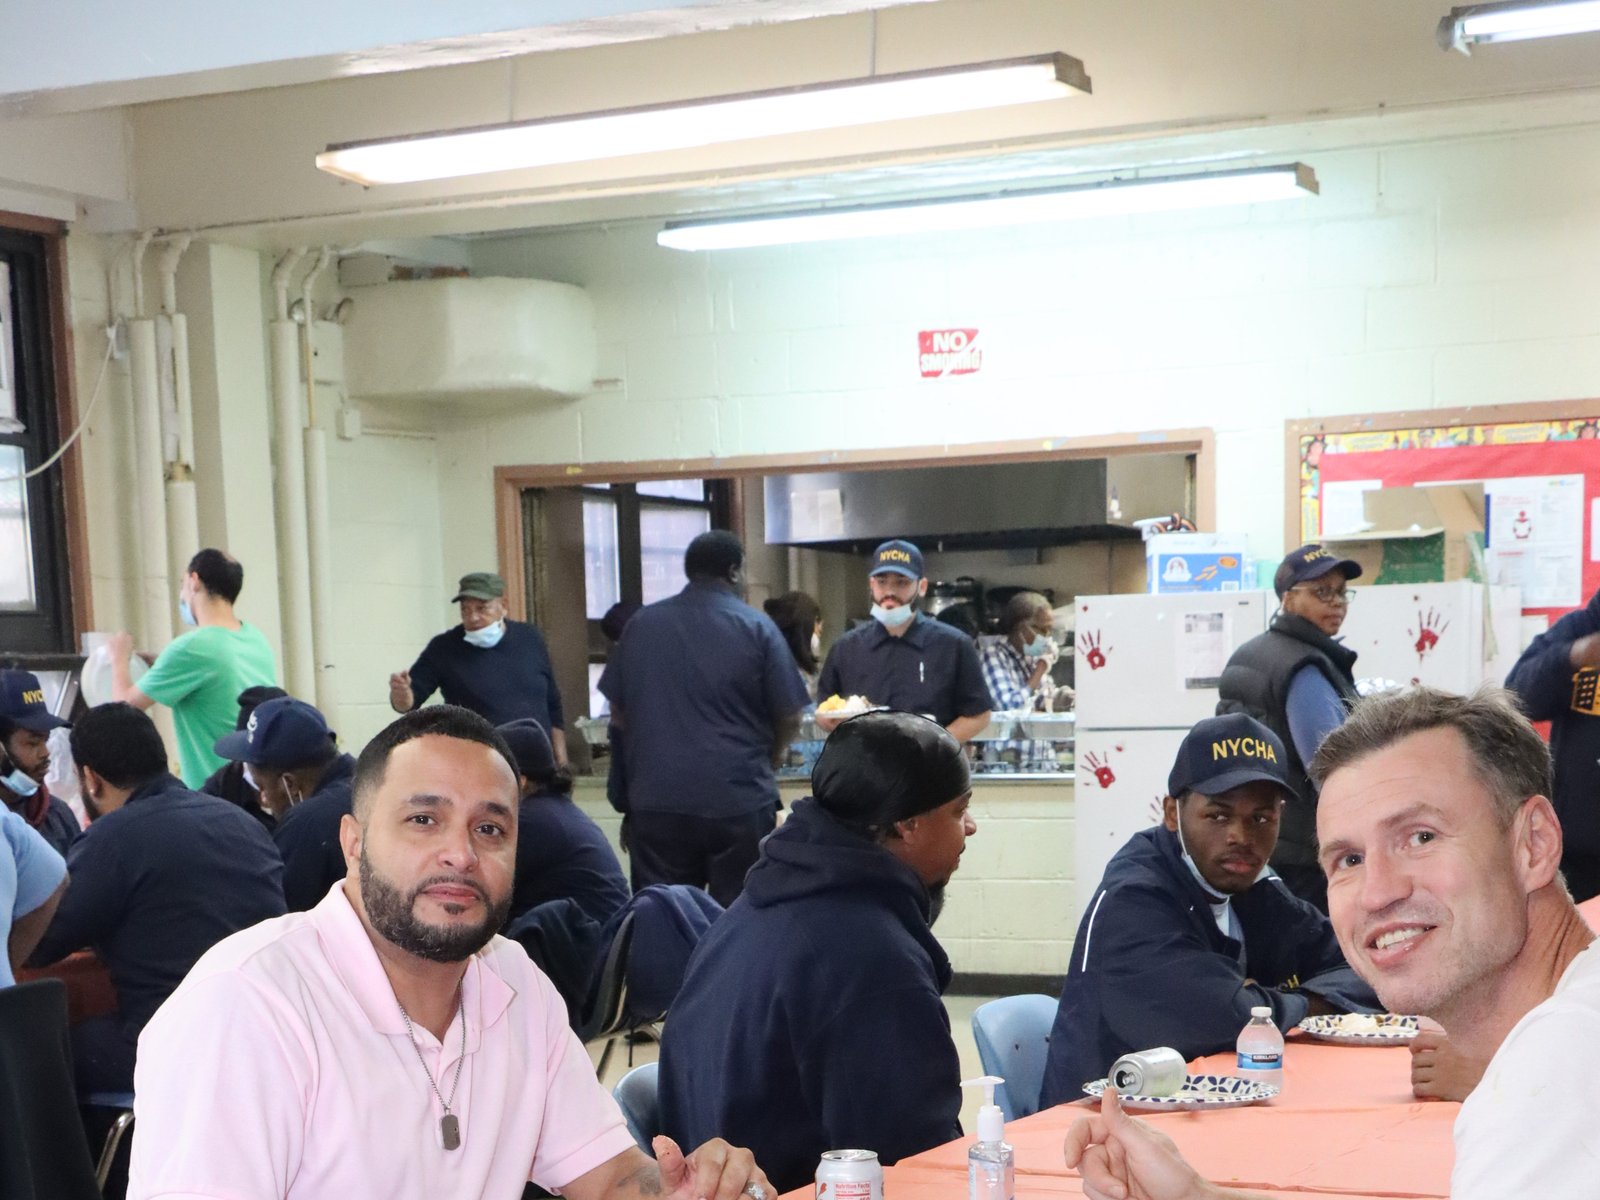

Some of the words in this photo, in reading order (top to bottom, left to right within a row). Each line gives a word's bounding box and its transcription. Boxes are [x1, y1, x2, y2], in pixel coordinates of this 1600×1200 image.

[933, 331, 967, 352] NO
[880, 550, 910, 563] NYCHA
[1212, 737, 1277, 764] NYCHA
